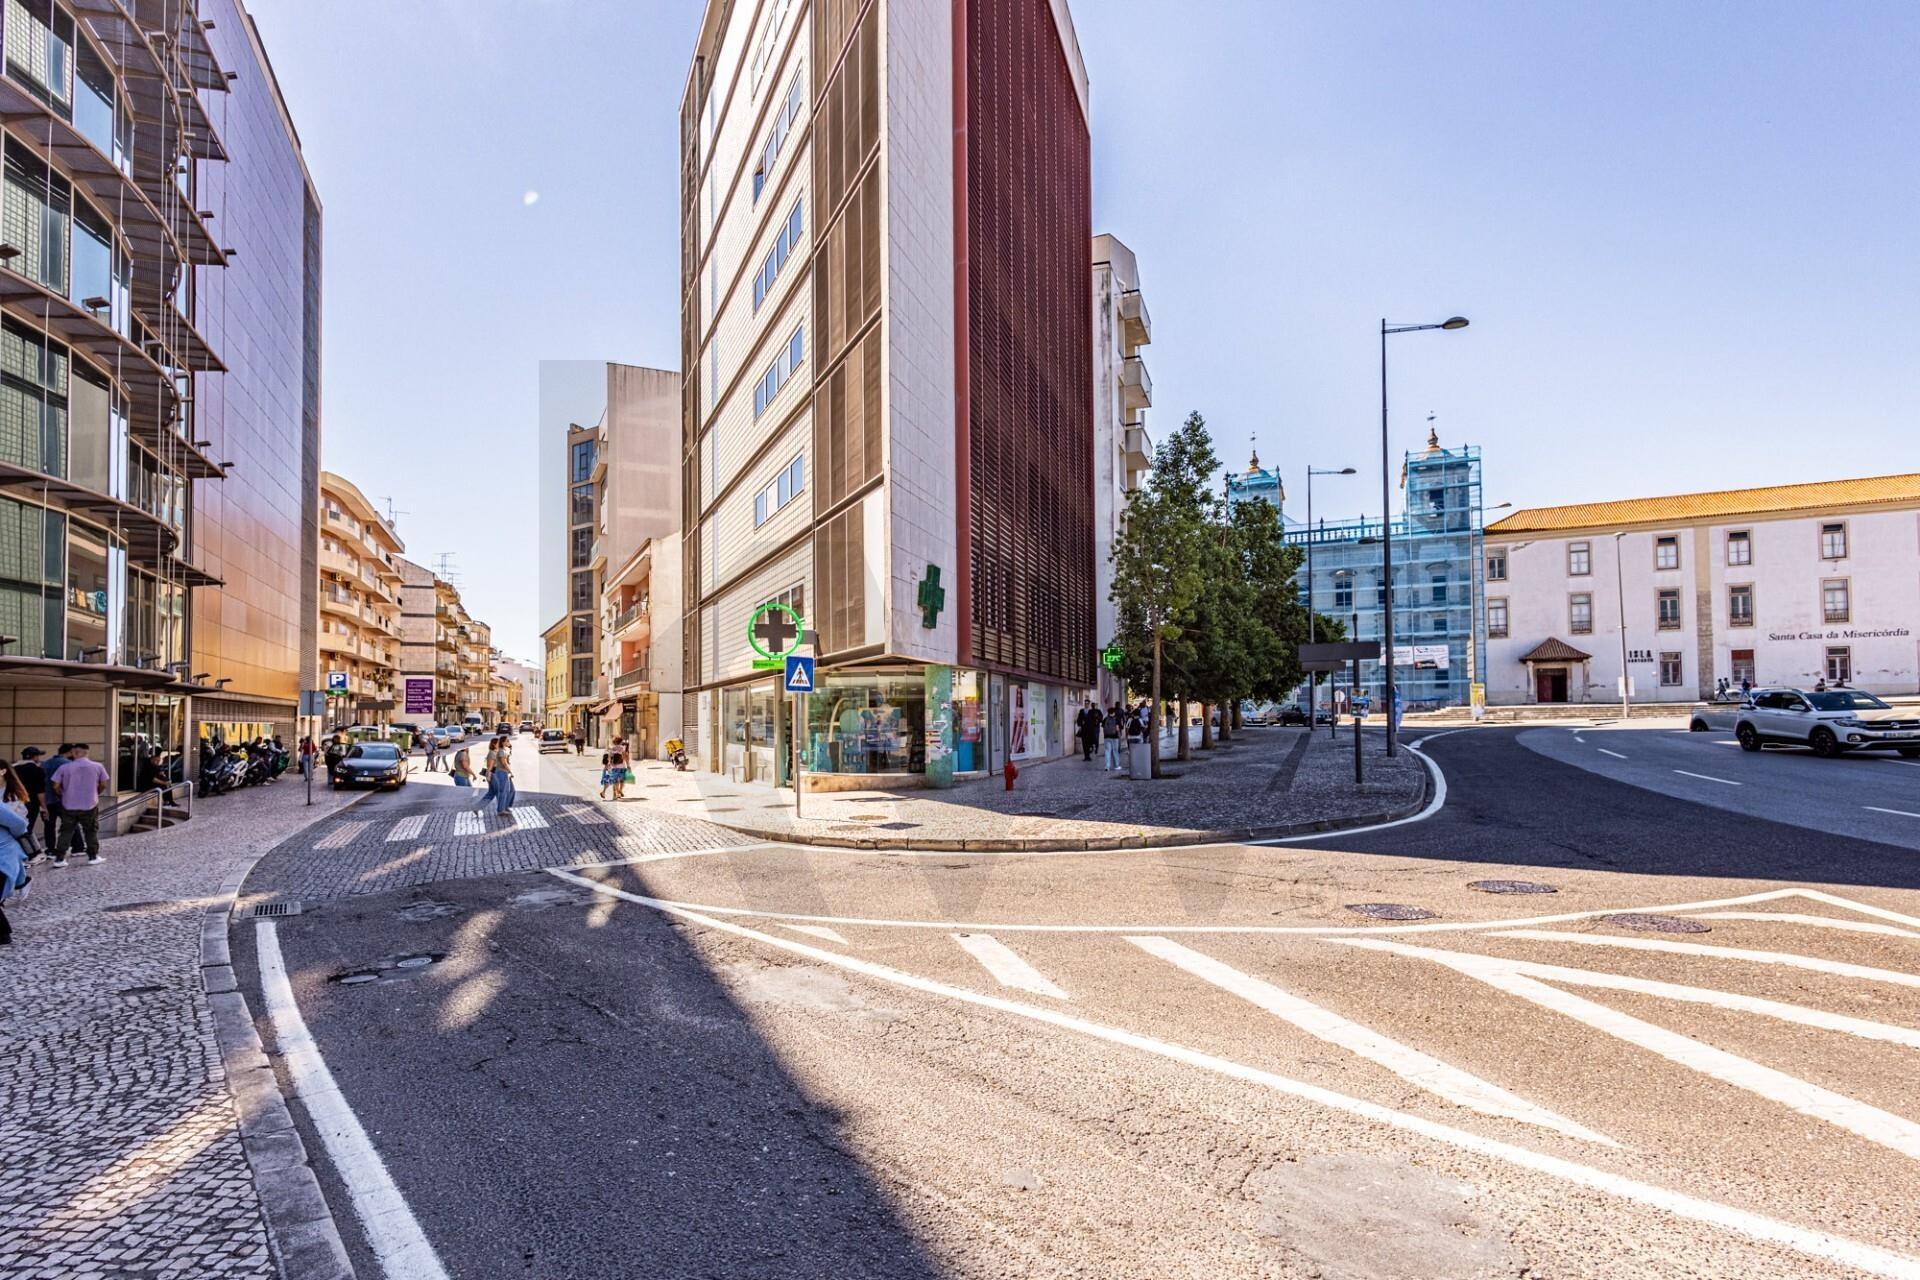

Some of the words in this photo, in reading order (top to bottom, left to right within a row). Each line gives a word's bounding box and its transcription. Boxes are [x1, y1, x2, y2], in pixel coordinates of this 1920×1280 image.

[1768, 632, 1795, 641] Santa
[1799, 632, 1822, 640] Casa
[1826, 631, 1839, 639] da
[1842, 628, 1909, 639] Misericórdia
[1629, 649, 1652, 658] ISLA
[331, 674, 345, 685] P
